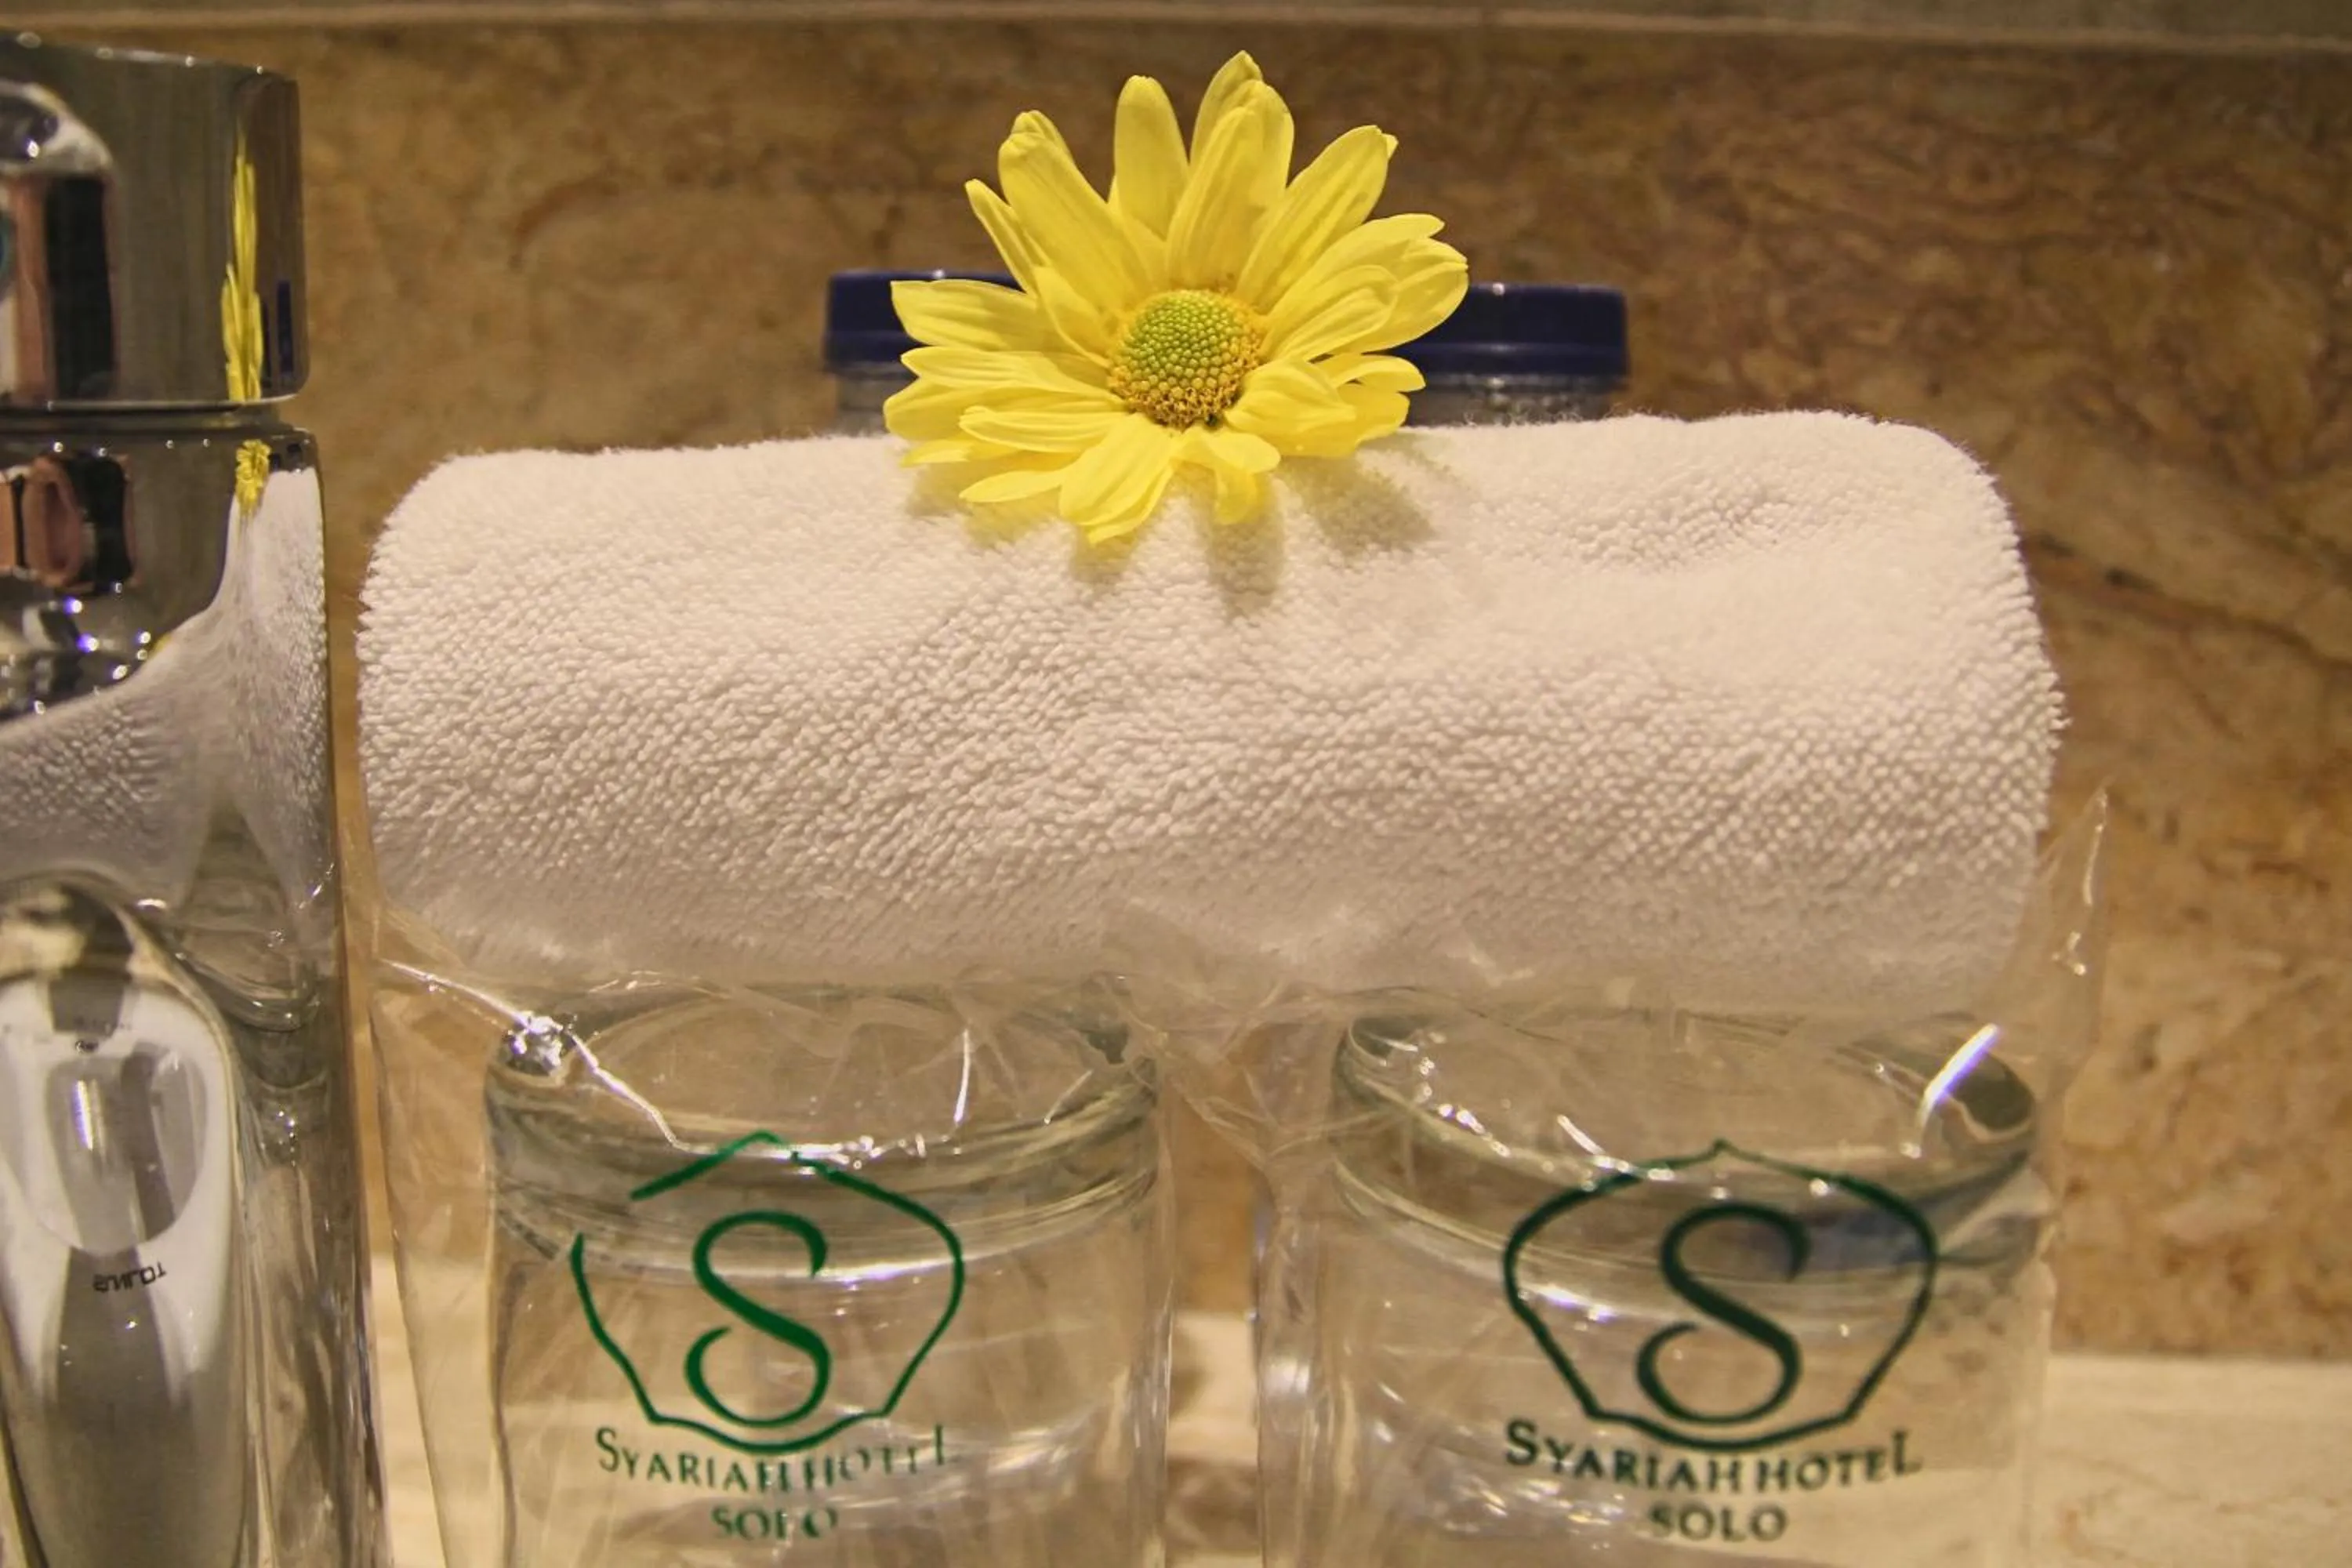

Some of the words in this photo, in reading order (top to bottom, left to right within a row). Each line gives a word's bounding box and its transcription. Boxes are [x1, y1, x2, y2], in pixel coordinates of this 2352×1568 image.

[684, 1211, 832, 1428] S
[1635, 1202, 1809, 1425] S
[1505, 1420, 1740, 1491] SYARIAH
[1756, 1430, 1923, 1490] HOTEL
[1650, 1501, 1788, 1541] SOLO
